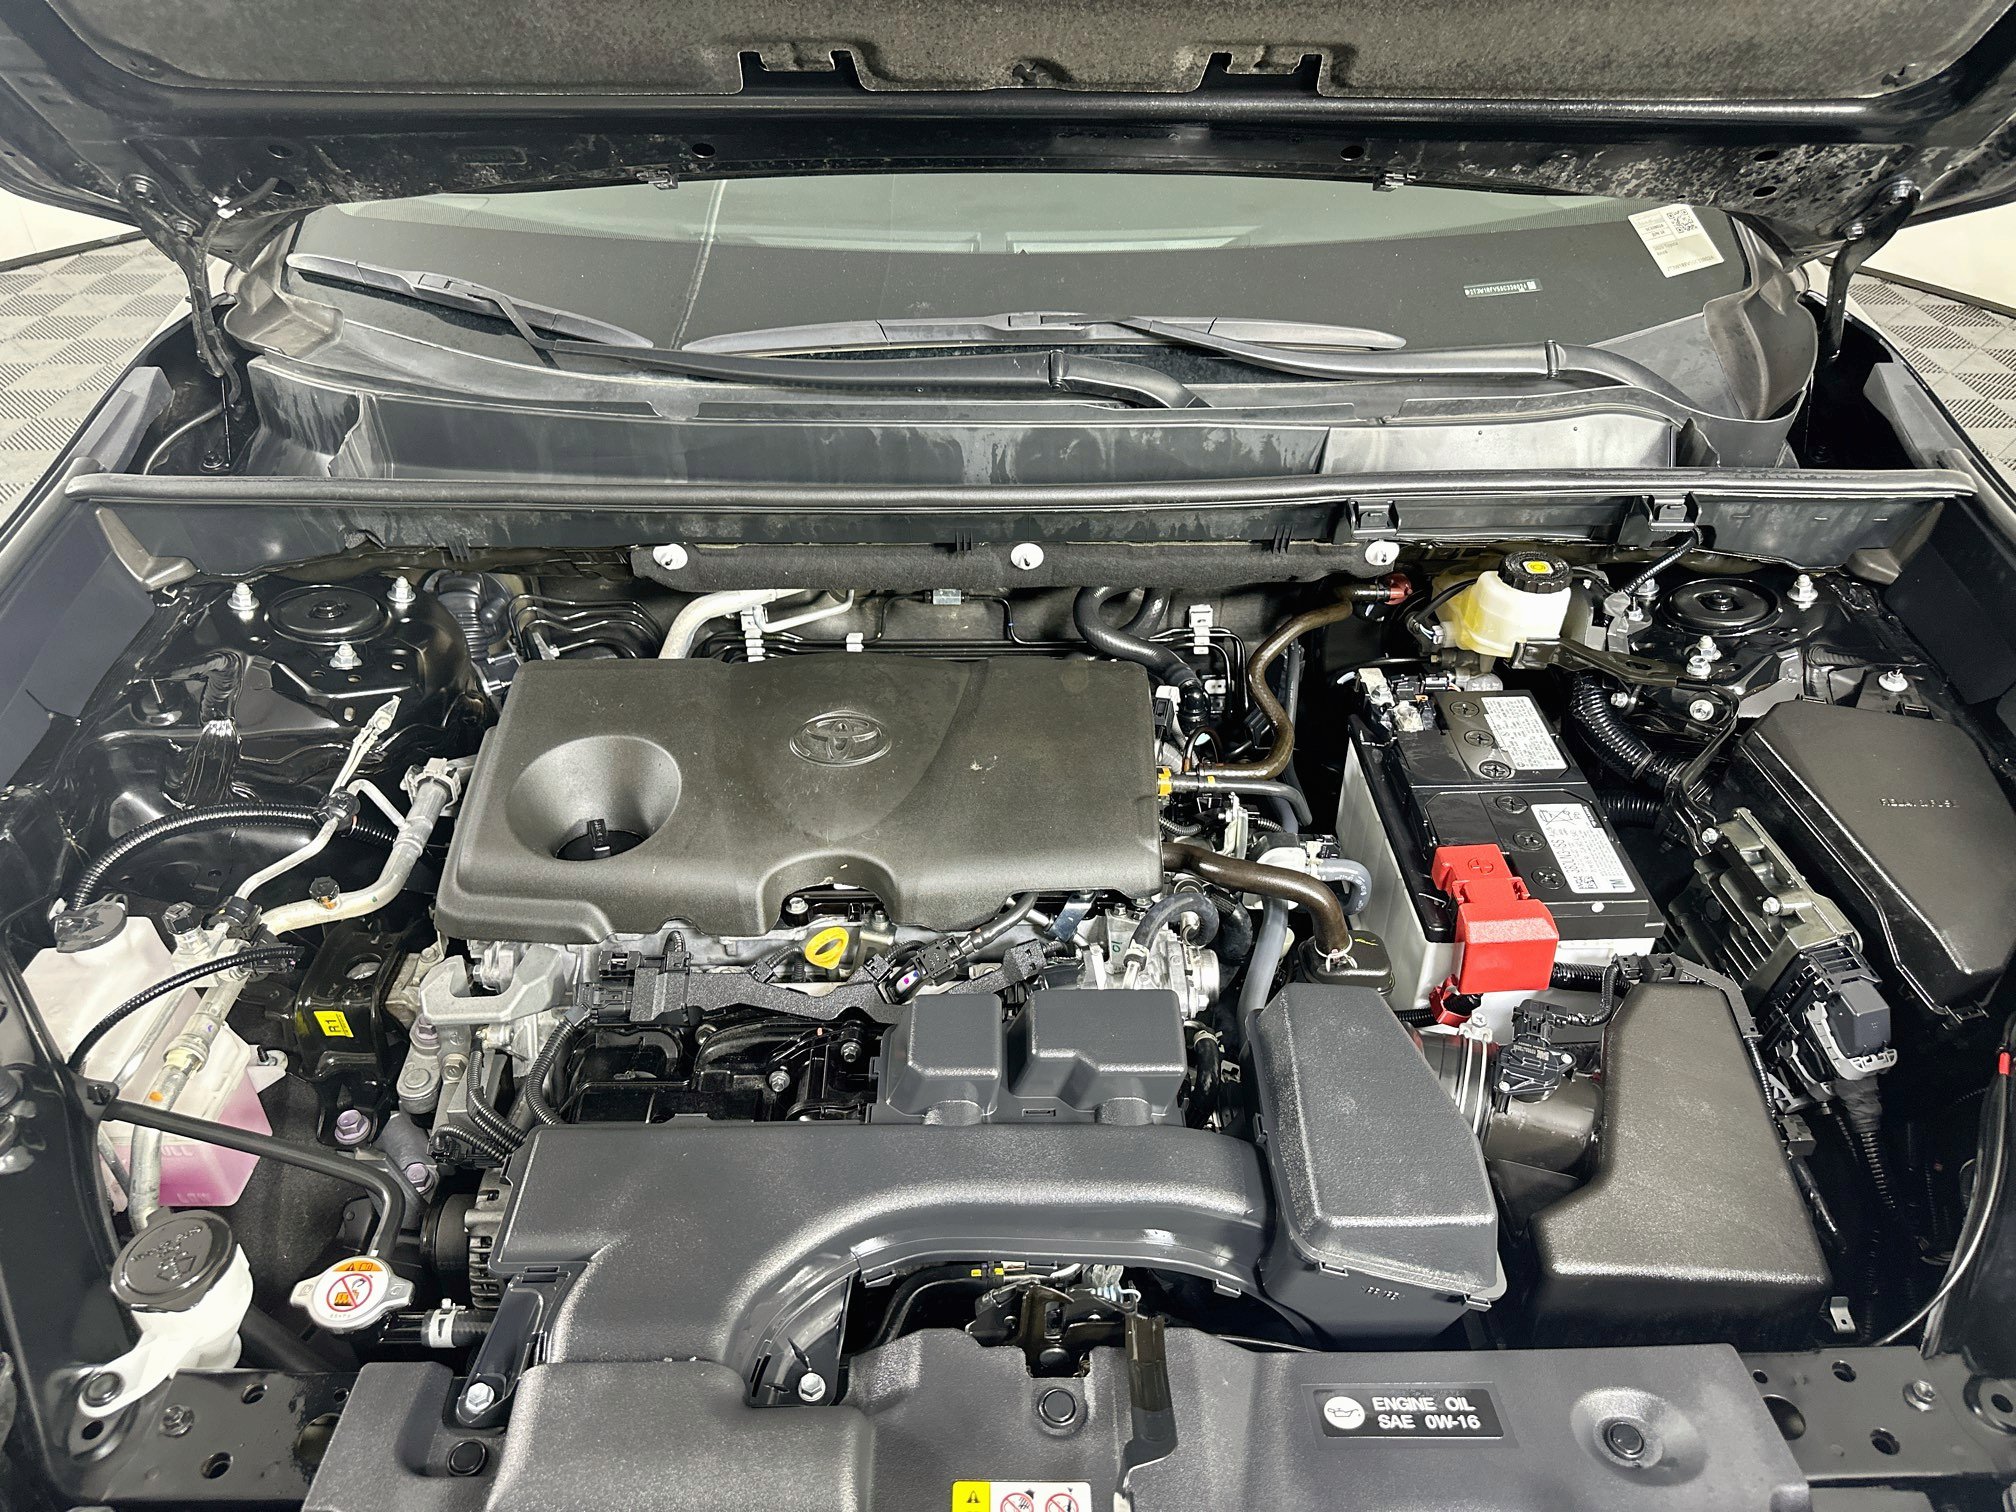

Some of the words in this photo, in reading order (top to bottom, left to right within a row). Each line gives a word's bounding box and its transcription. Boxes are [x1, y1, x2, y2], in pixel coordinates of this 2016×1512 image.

[1371, 1396, 1436, 1411] ENGINE
[1444, 1396, 1476, 1411] OIL
[1377, 1414, 1416, 1429] SAE
[1424, 1414, 1481, 1429] 0W-16
